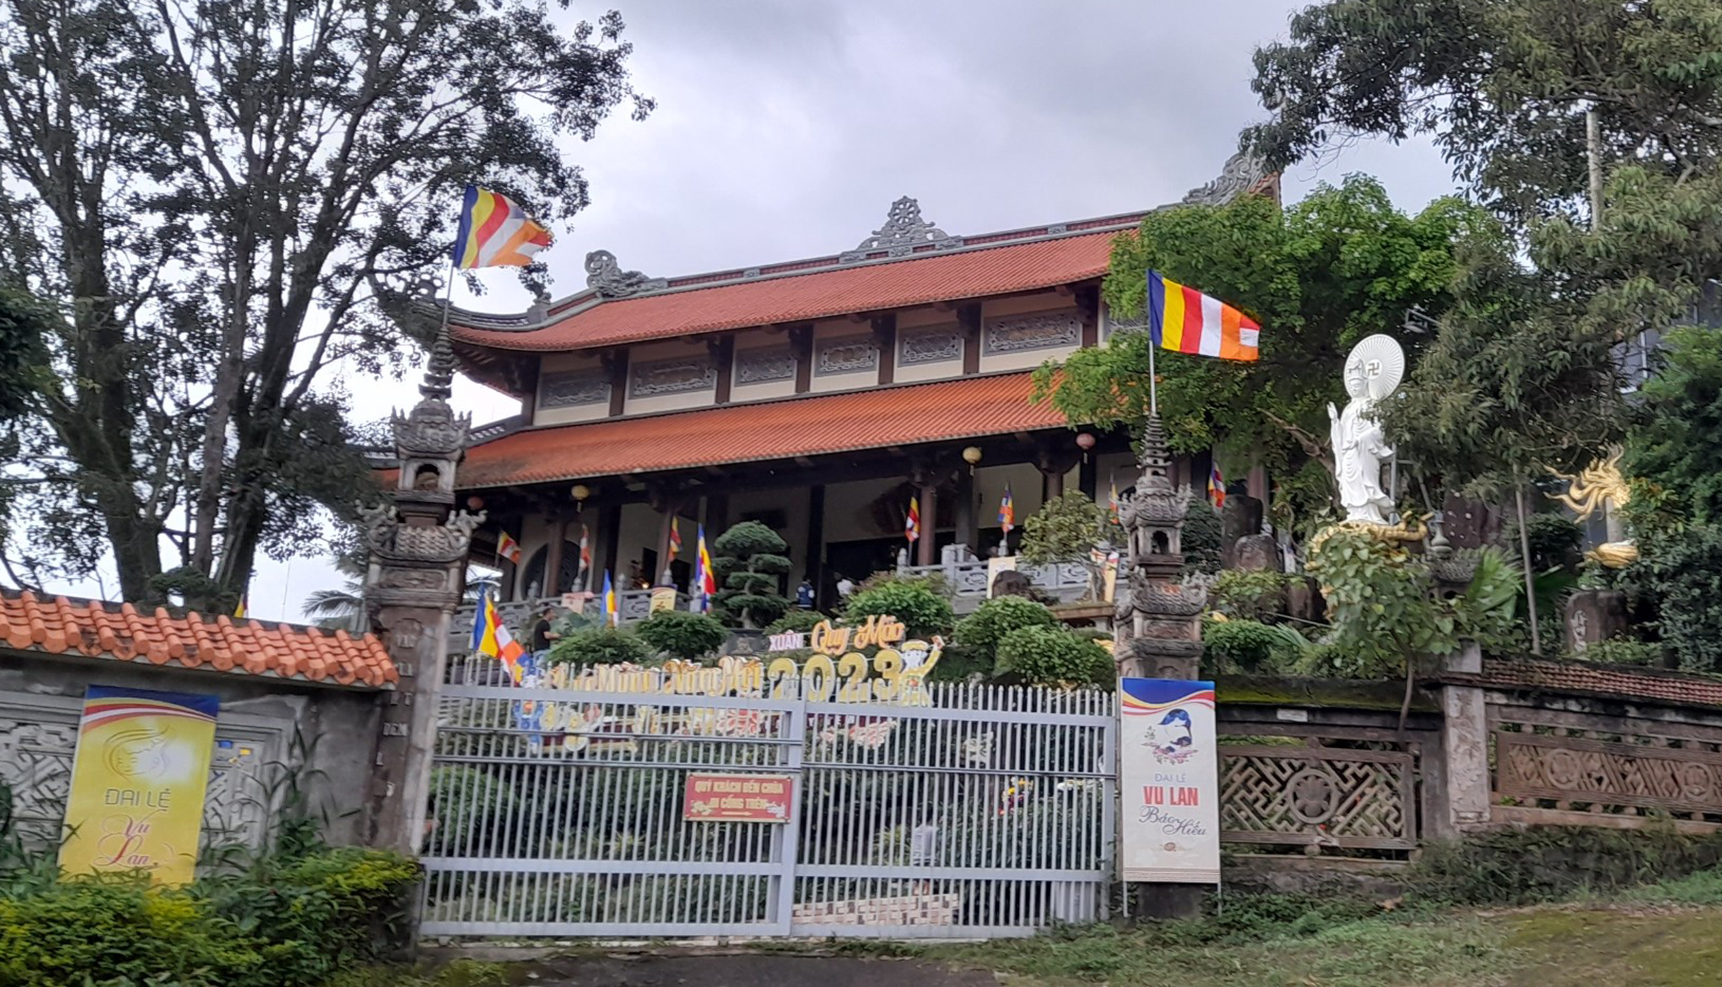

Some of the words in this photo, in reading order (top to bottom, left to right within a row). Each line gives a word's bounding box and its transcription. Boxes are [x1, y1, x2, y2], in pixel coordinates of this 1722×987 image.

[769, 629, 803, 651] XUÂN
[767, 649, 902, 702] 2023
[695, 779, 712, 793] QUÝ
[712, 779, 742, 793] KHÁCH
[1143, 785, 1164, 805] VU
[1169, 787, 1199, 806] LAN
[1138, 805, 1177, 824] Báo
[1162, 818, 1207, 836] Hiếu
[93, 834, 163, 870] Lan
